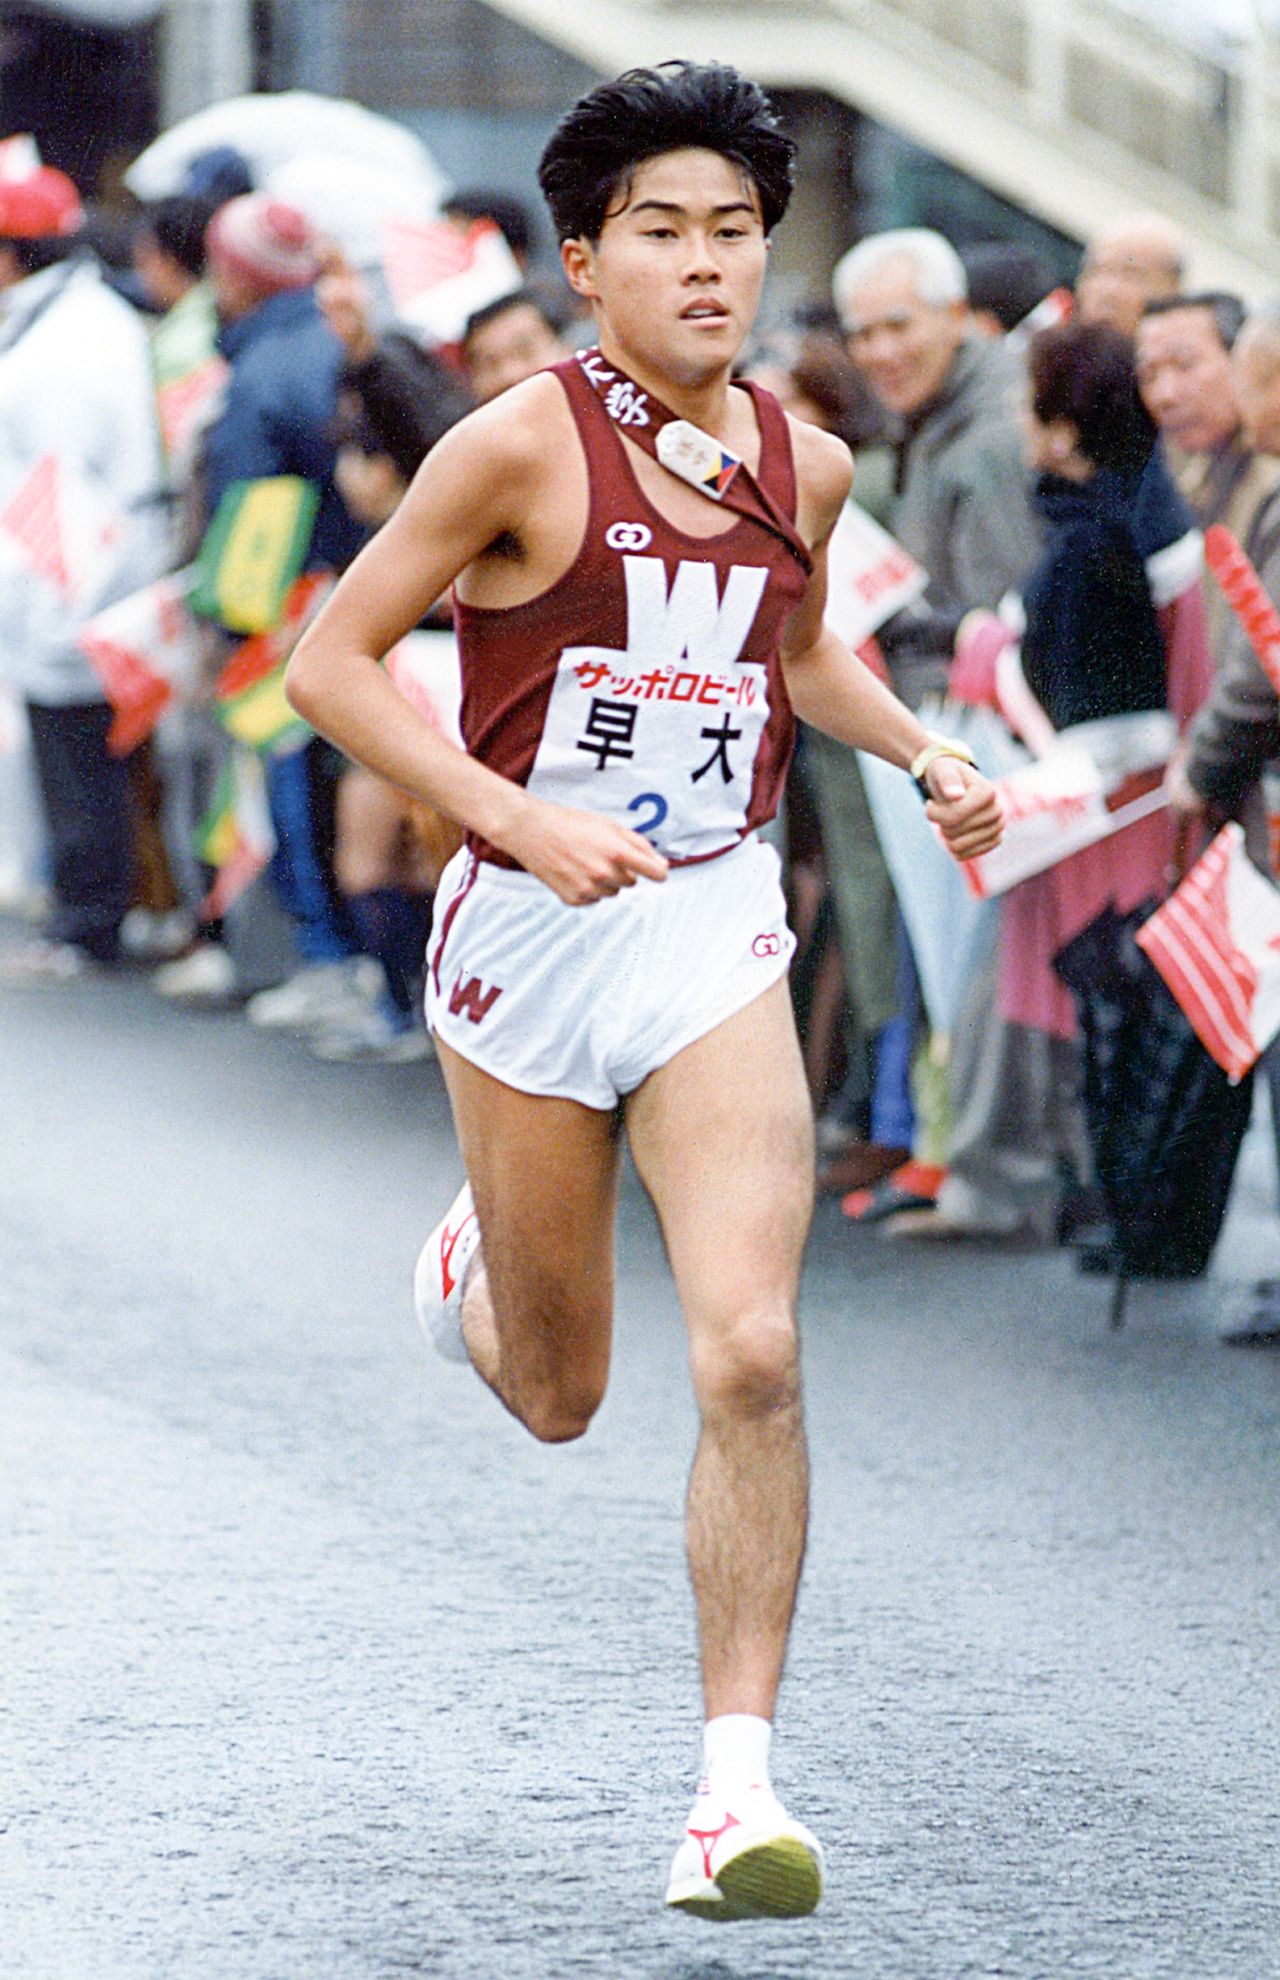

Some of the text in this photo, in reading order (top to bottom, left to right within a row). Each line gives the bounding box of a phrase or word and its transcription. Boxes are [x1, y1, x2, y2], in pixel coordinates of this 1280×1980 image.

[576, 345, 650, 427] 大学
[622, 555, 769, 662] W
[573, 661, 757, 707] サッポロビール
[627, 793, 668, 847] 2
[448, 967, 503, 1025] W
